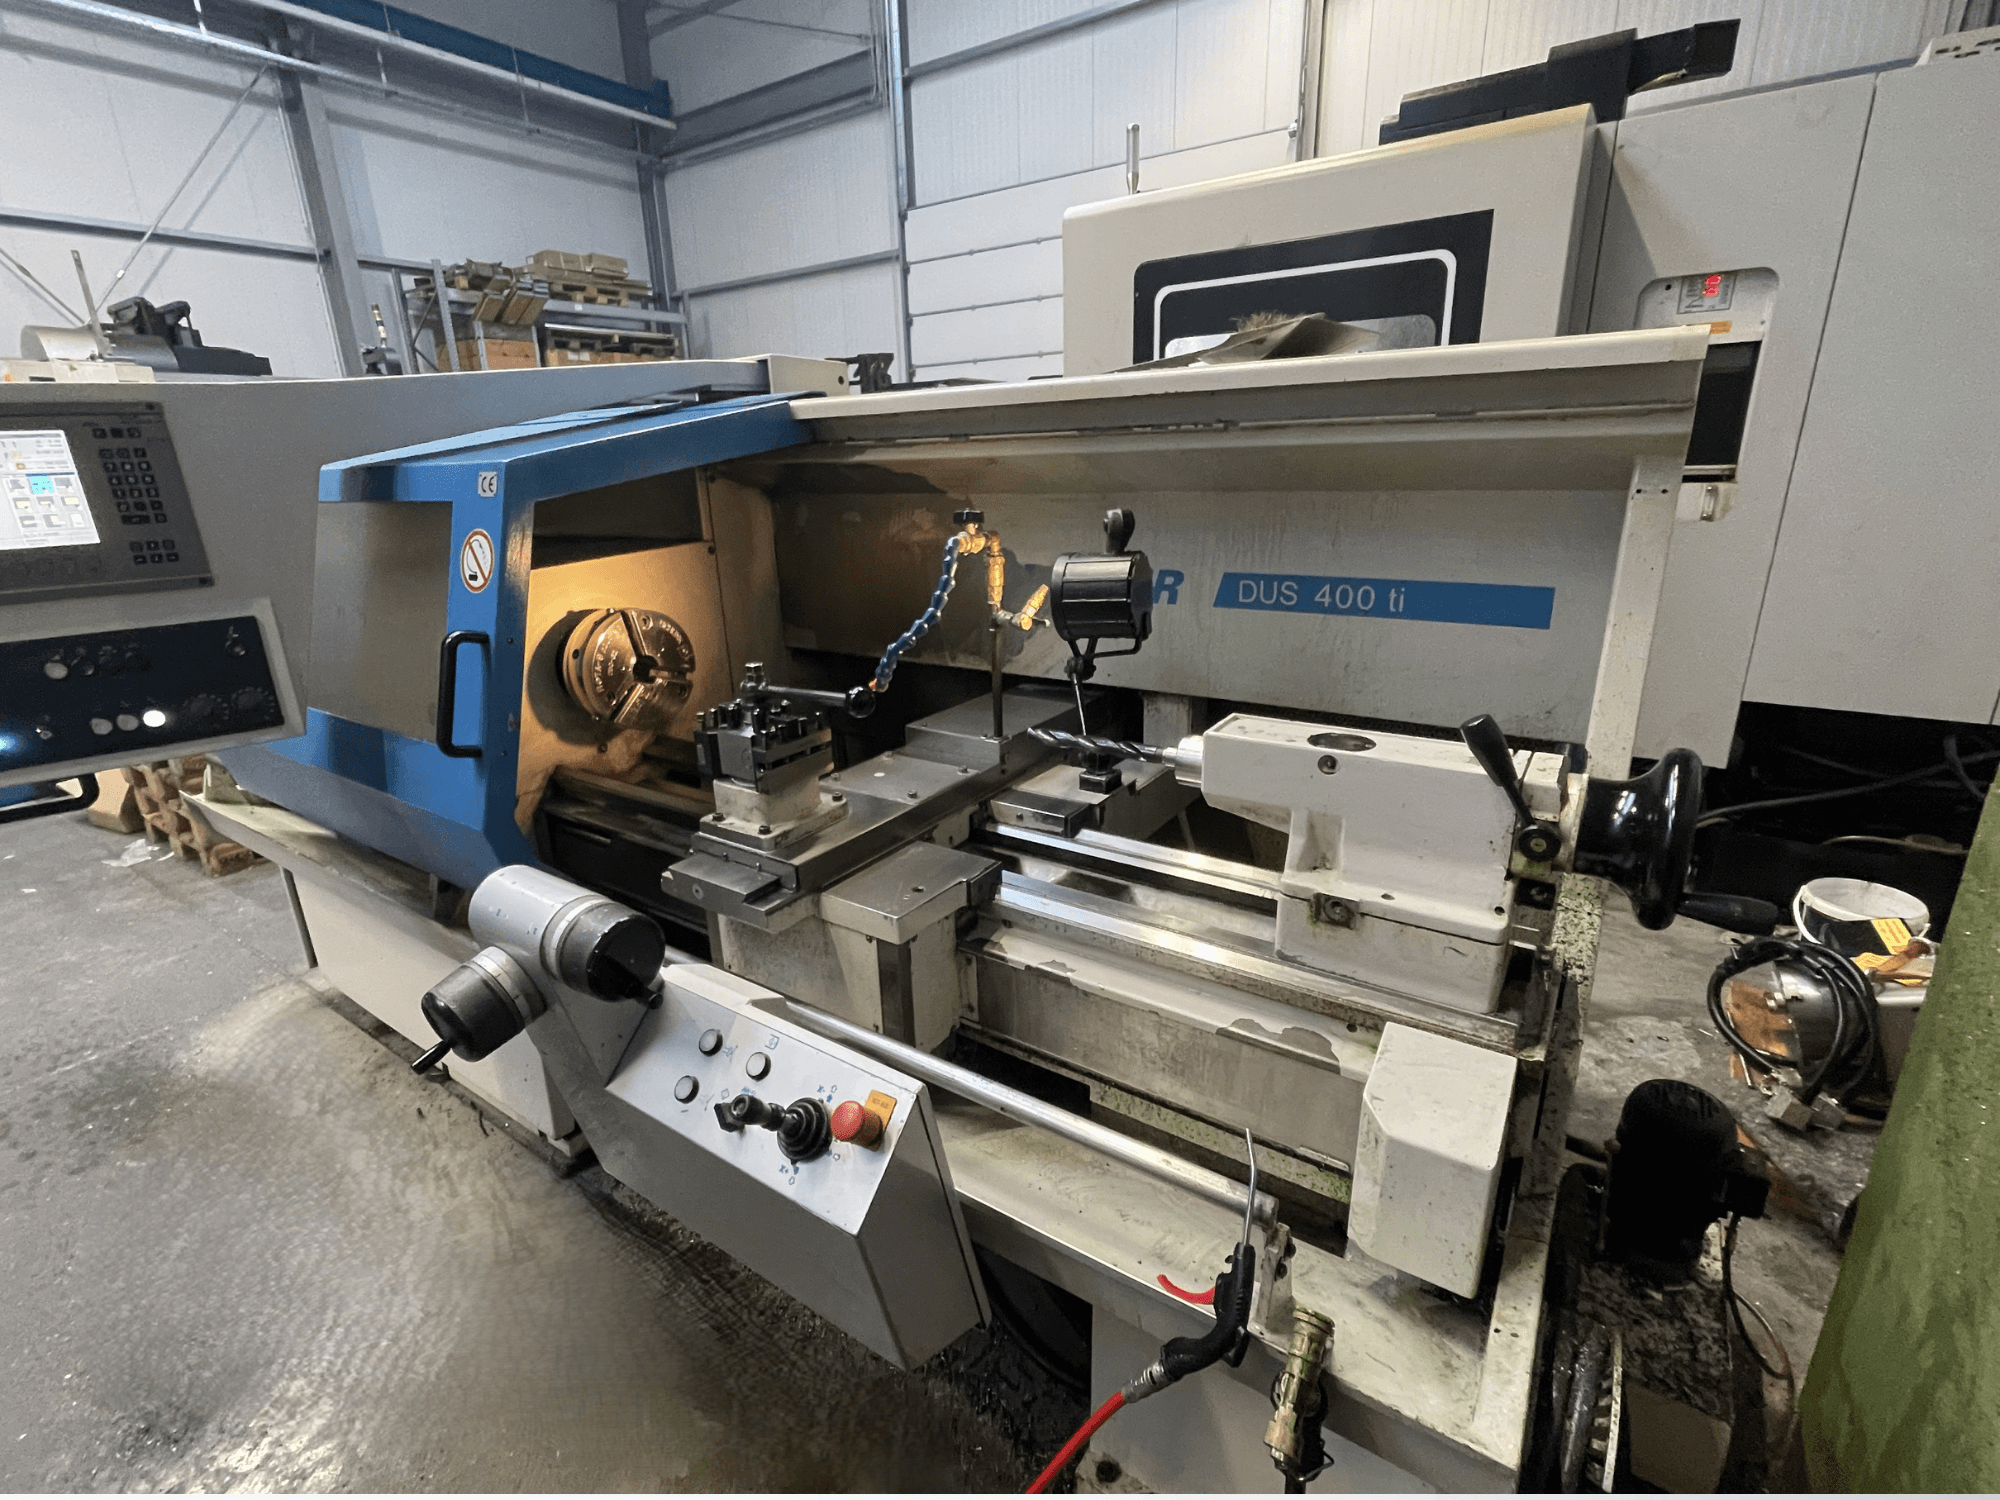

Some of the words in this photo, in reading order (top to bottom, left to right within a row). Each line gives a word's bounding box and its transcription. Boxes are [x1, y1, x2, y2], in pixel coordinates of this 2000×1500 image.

[481, 476, 494, 493] CE
[1239, 579, 1298, 606] DUS
[1314, 583, 1376, 611] 400
[1388, 587, 1405, 613] ti
